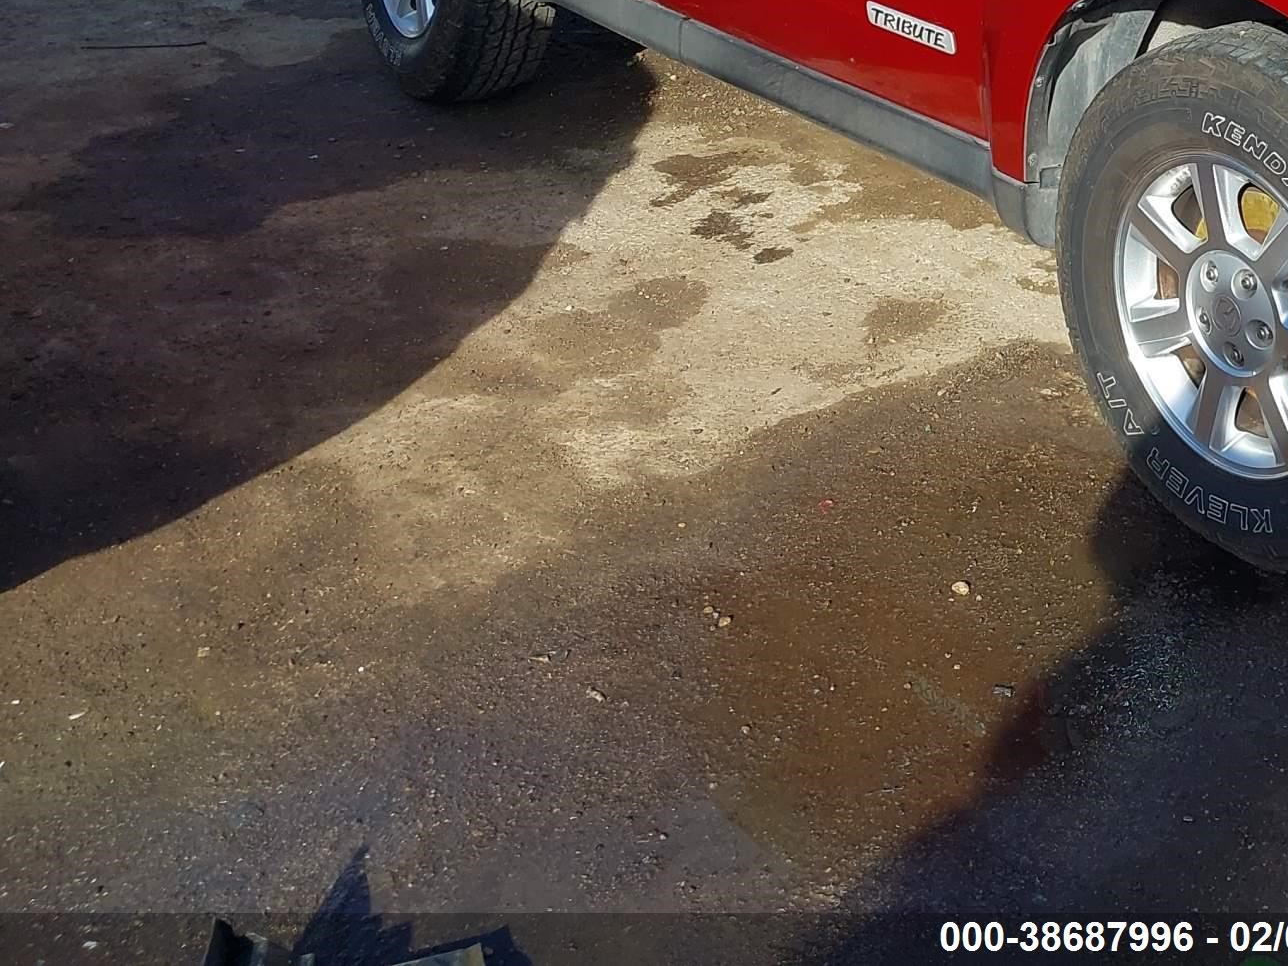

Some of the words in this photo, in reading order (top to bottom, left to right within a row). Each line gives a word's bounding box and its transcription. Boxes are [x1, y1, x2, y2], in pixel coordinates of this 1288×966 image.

[871, 7, 946, 49] TRIBUTE
[1096, 371, 1145, 436] A/T
[1145, 446, 1273, 534] KLEVER
